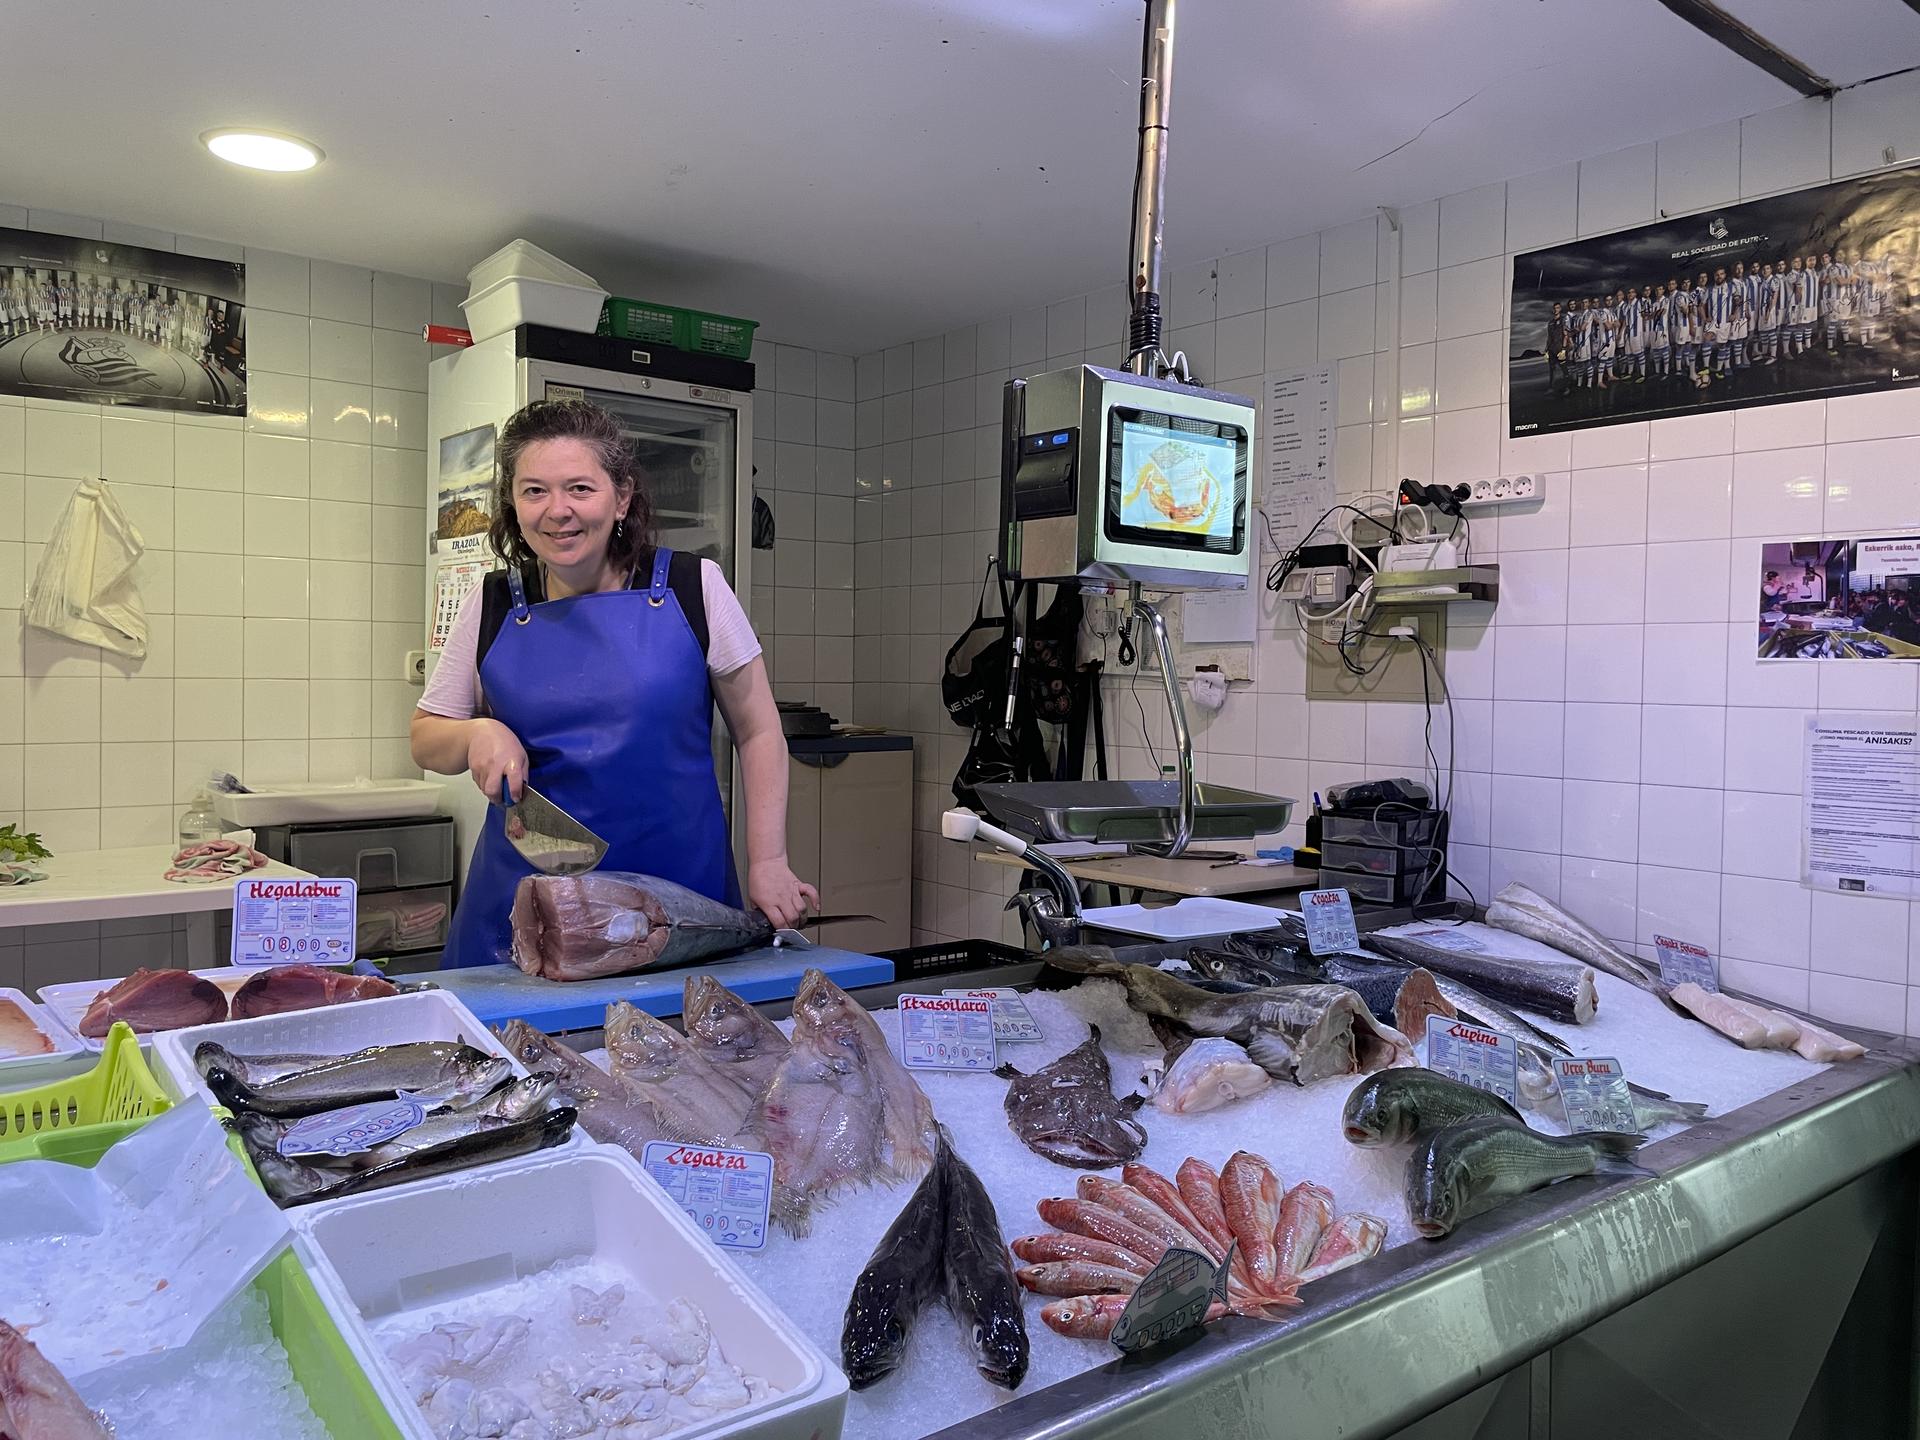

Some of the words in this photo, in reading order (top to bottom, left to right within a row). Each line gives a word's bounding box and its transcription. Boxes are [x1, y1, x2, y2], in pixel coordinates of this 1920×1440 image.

[1671, 251, 1690, 259] REAL
[1690, 242, 1727, 255] SOCIEDAD
[1728, 239, 1739, 248] DE
[451, 537, 481, 550] IRAZOLA
[440, 600, 444, 610] 4
[448, 600, 453, 610] 5
[446, 612, 452, 622] 12
[433, 638, 441, 647] 25
[1864, 736, 1913, 746] ANISAKIS?
[250, 881, 342, 900] Hegalabur
[1446, 1023, 1498, 1047] Lupina
[1561, 1061, 1585, 1077] Urre
[665, 1147, 749, 1170] Legatza
